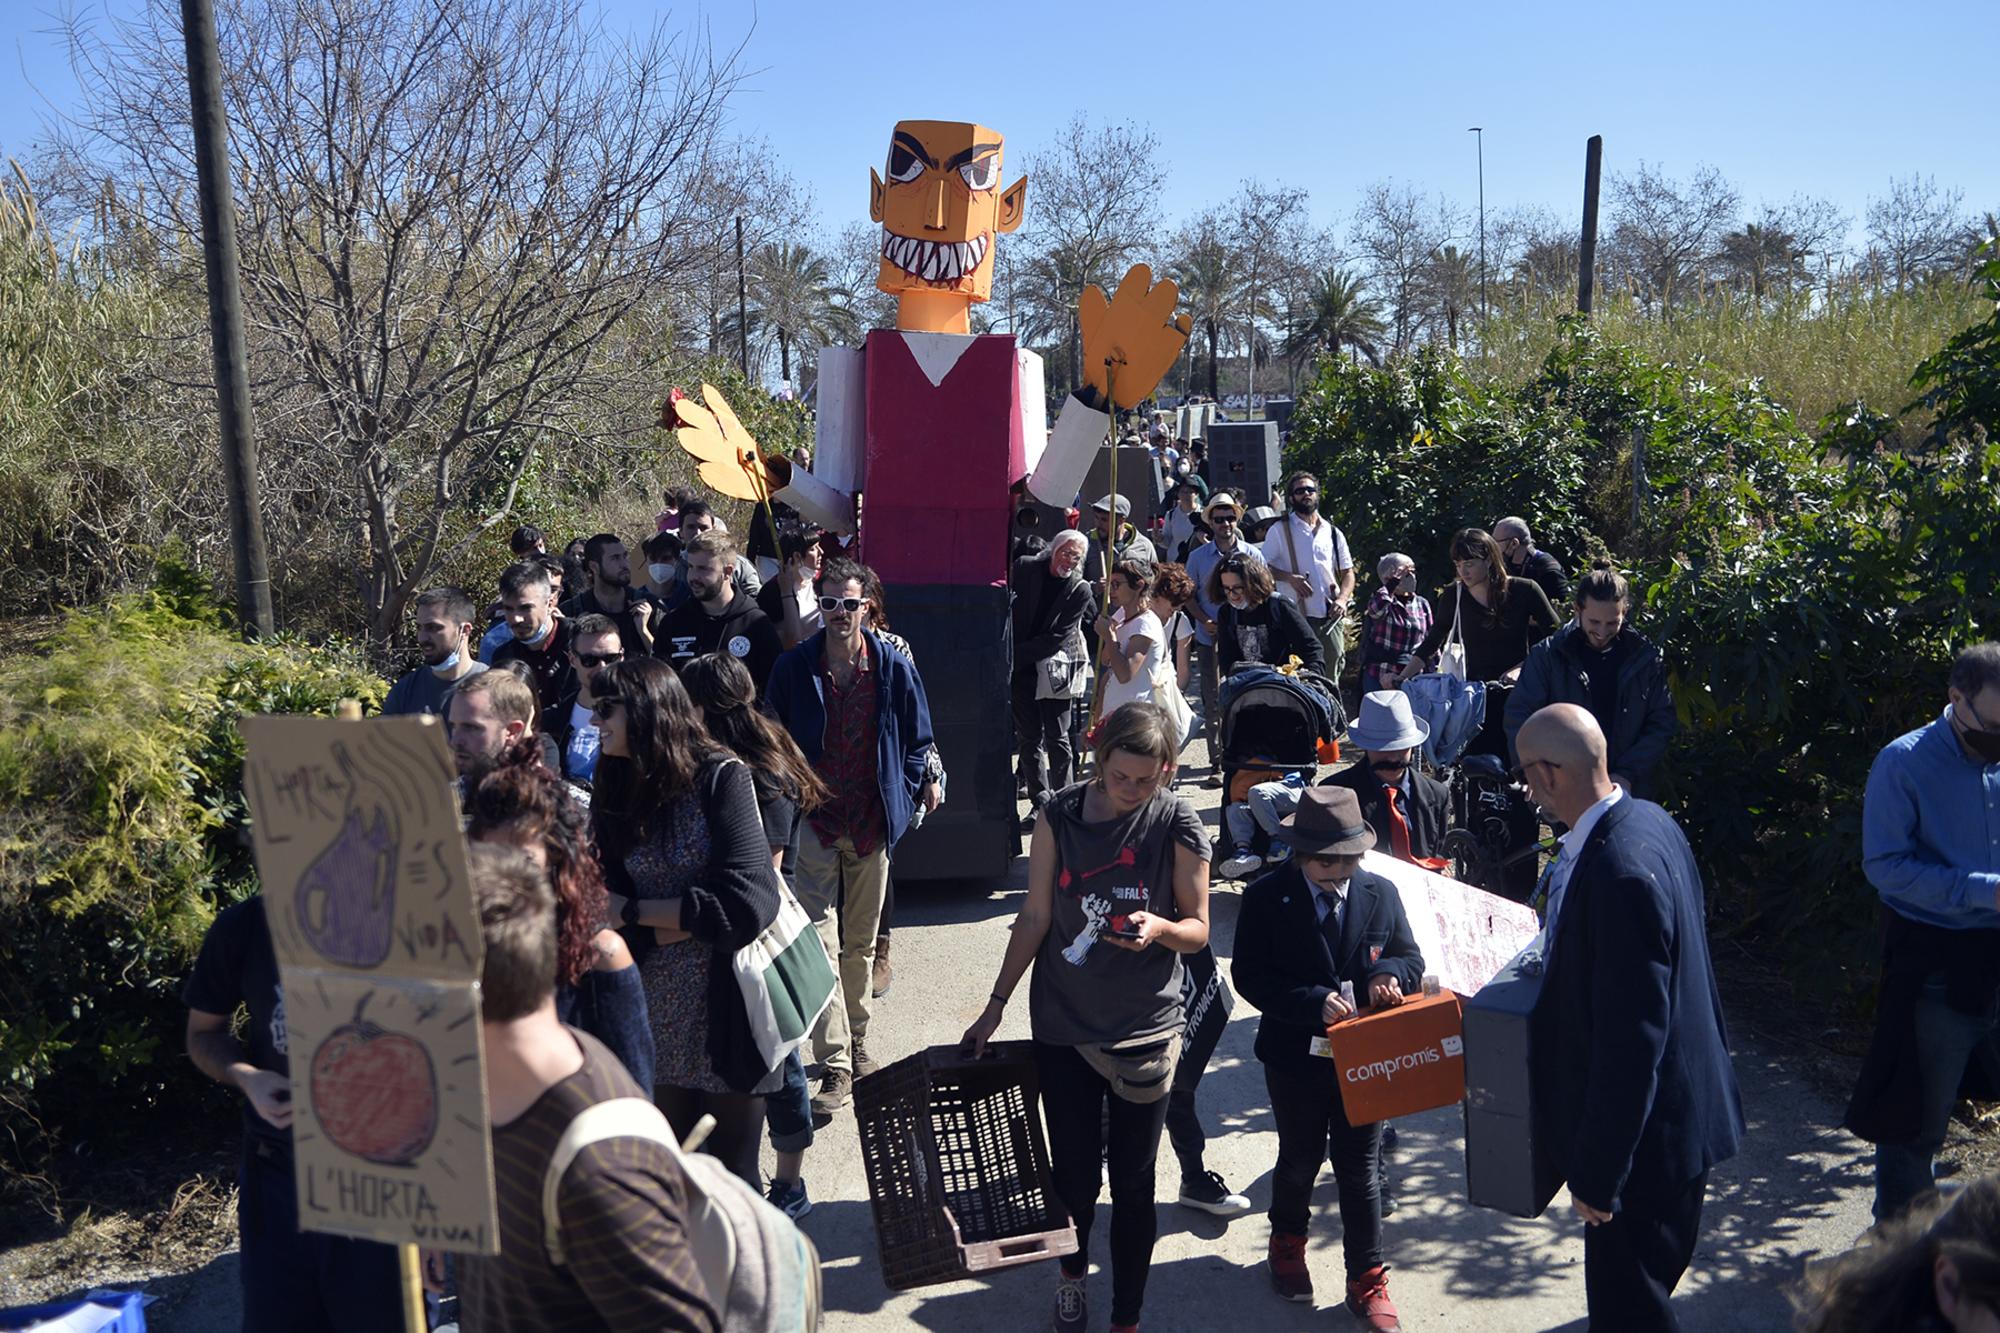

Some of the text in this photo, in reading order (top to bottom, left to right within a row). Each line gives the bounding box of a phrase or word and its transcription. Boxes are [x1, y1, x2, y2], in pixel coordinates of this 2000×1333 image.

[250, 757, 344, 844] L'HORTA
[406, 840, 453, 900] ÉS
[1346, 1046, 1440, 1081] compromís
[308, 1165, 438, 1222] L'HORTA
[411, 1223, 485, 1249] VIVA!
